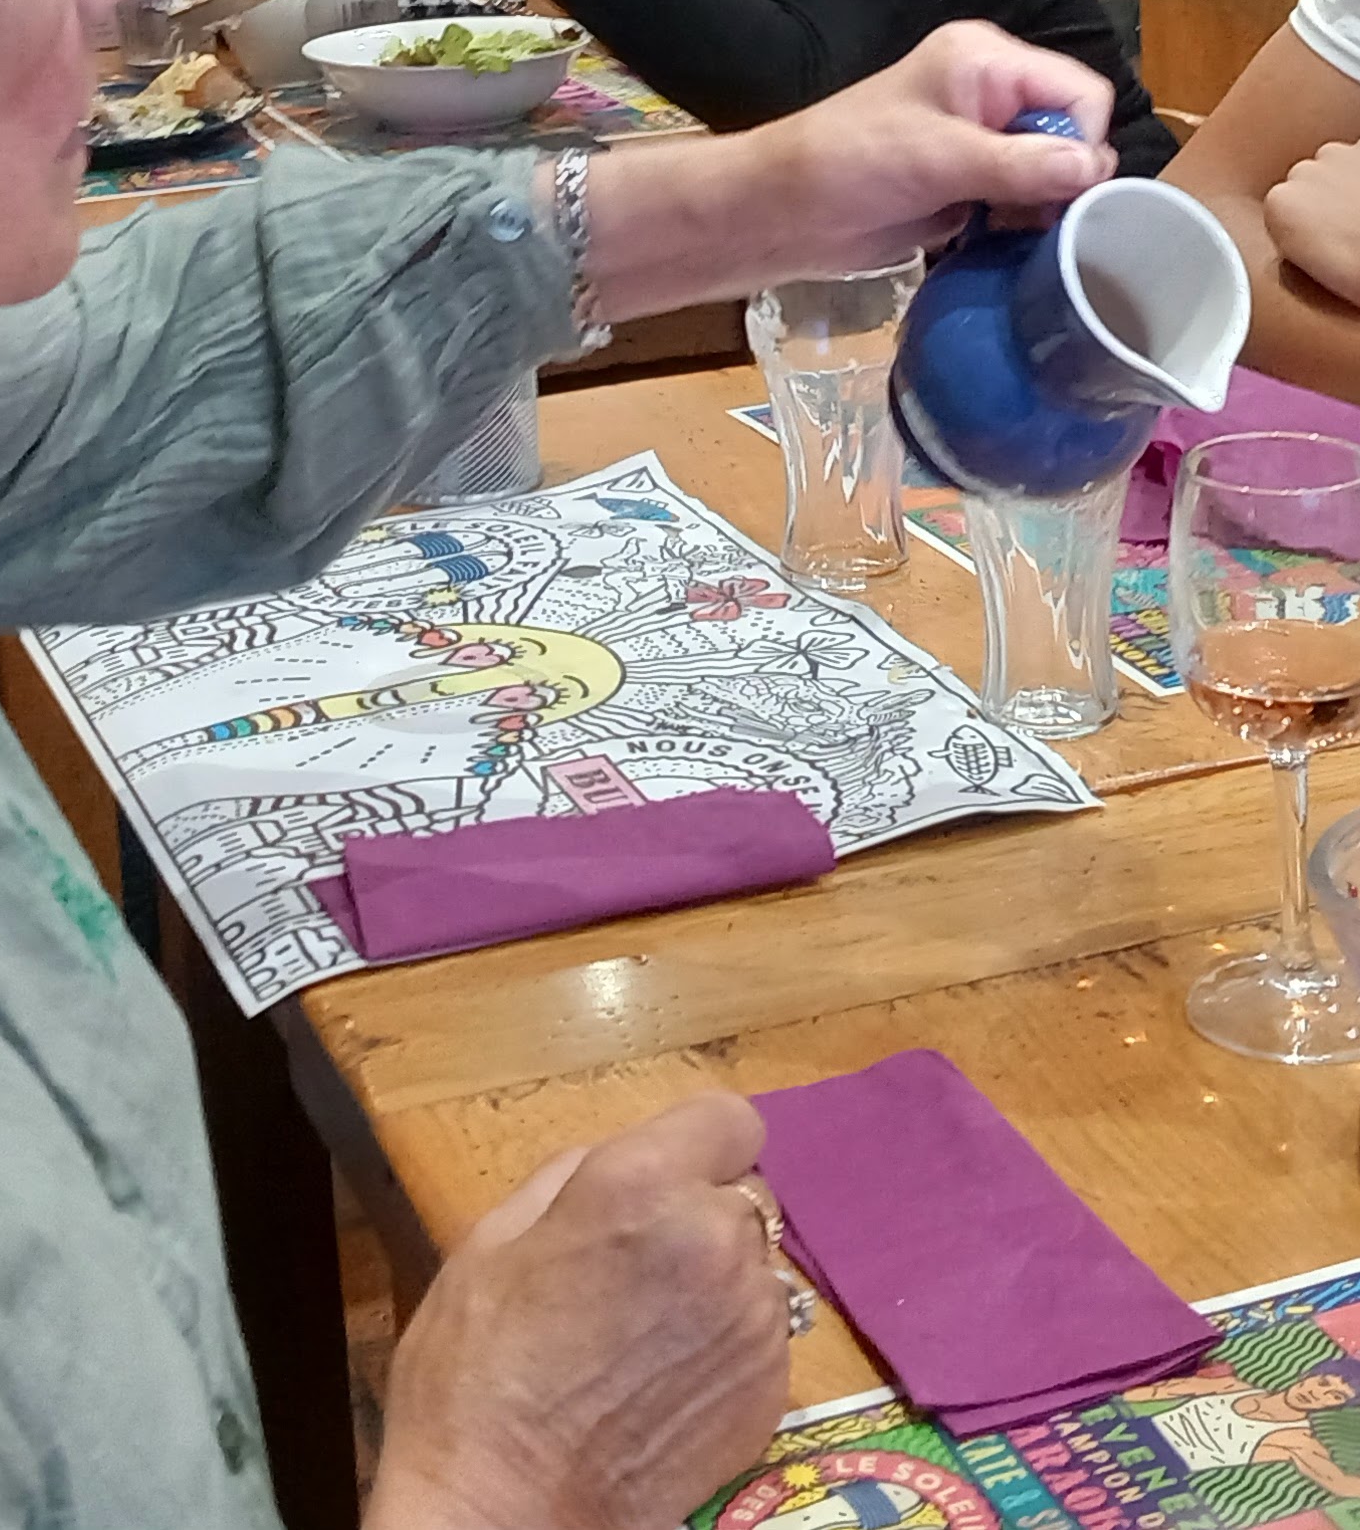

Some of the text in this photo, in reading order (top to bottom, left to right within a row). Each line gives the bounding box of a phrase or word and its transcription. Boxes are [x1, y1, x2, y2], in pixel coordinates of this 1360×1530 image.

[410, 521, 546, 591] LE SOLEIL FAIT
[291, 585, 422, 610] QUETTES
[627, 739, 820, 796] NOUS ON SE
[834, 1455, 879, 1474] LE
[1048, 1410, 1148, 1504] AMPION
